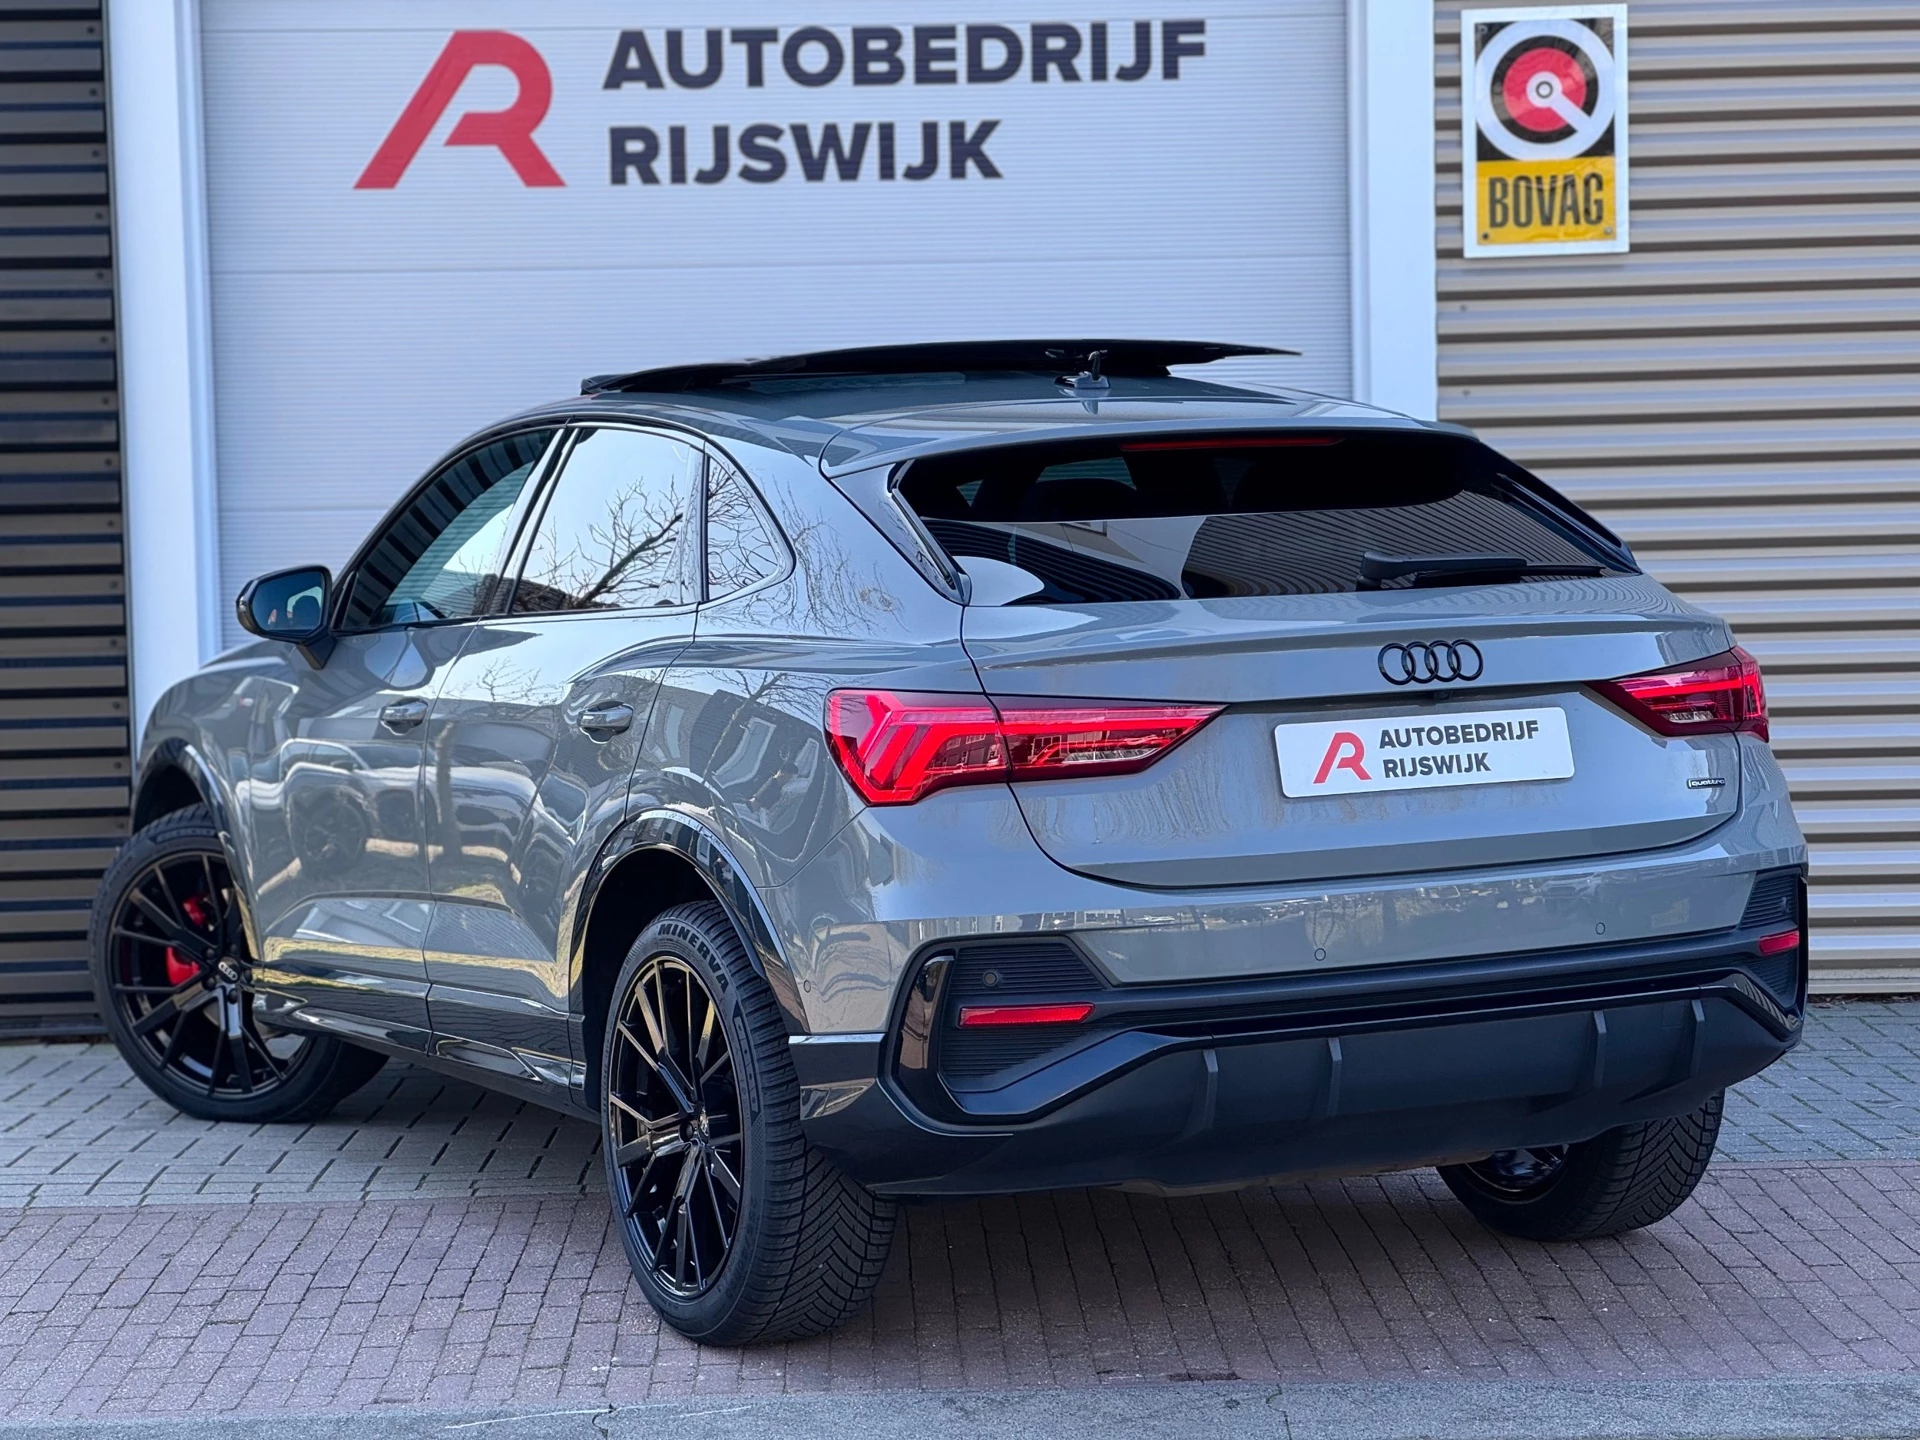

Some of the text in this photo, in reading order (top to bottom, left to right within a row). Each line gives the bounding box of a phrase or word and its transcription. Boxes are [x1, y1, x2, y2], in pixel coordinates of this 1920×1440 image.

[603, 20, 1205, 90] AUTOBEDRIJF
[609, 119, 1003, 186] RIJSWIJK
[1489, 172, 1604, 228] BOVAG
[1379, 720, 1539, 749] AUTOBEDRIJF
[1383, 753, 1491, 778] RIJSWIJK
[657, 923, 729, 994] MINERVA
